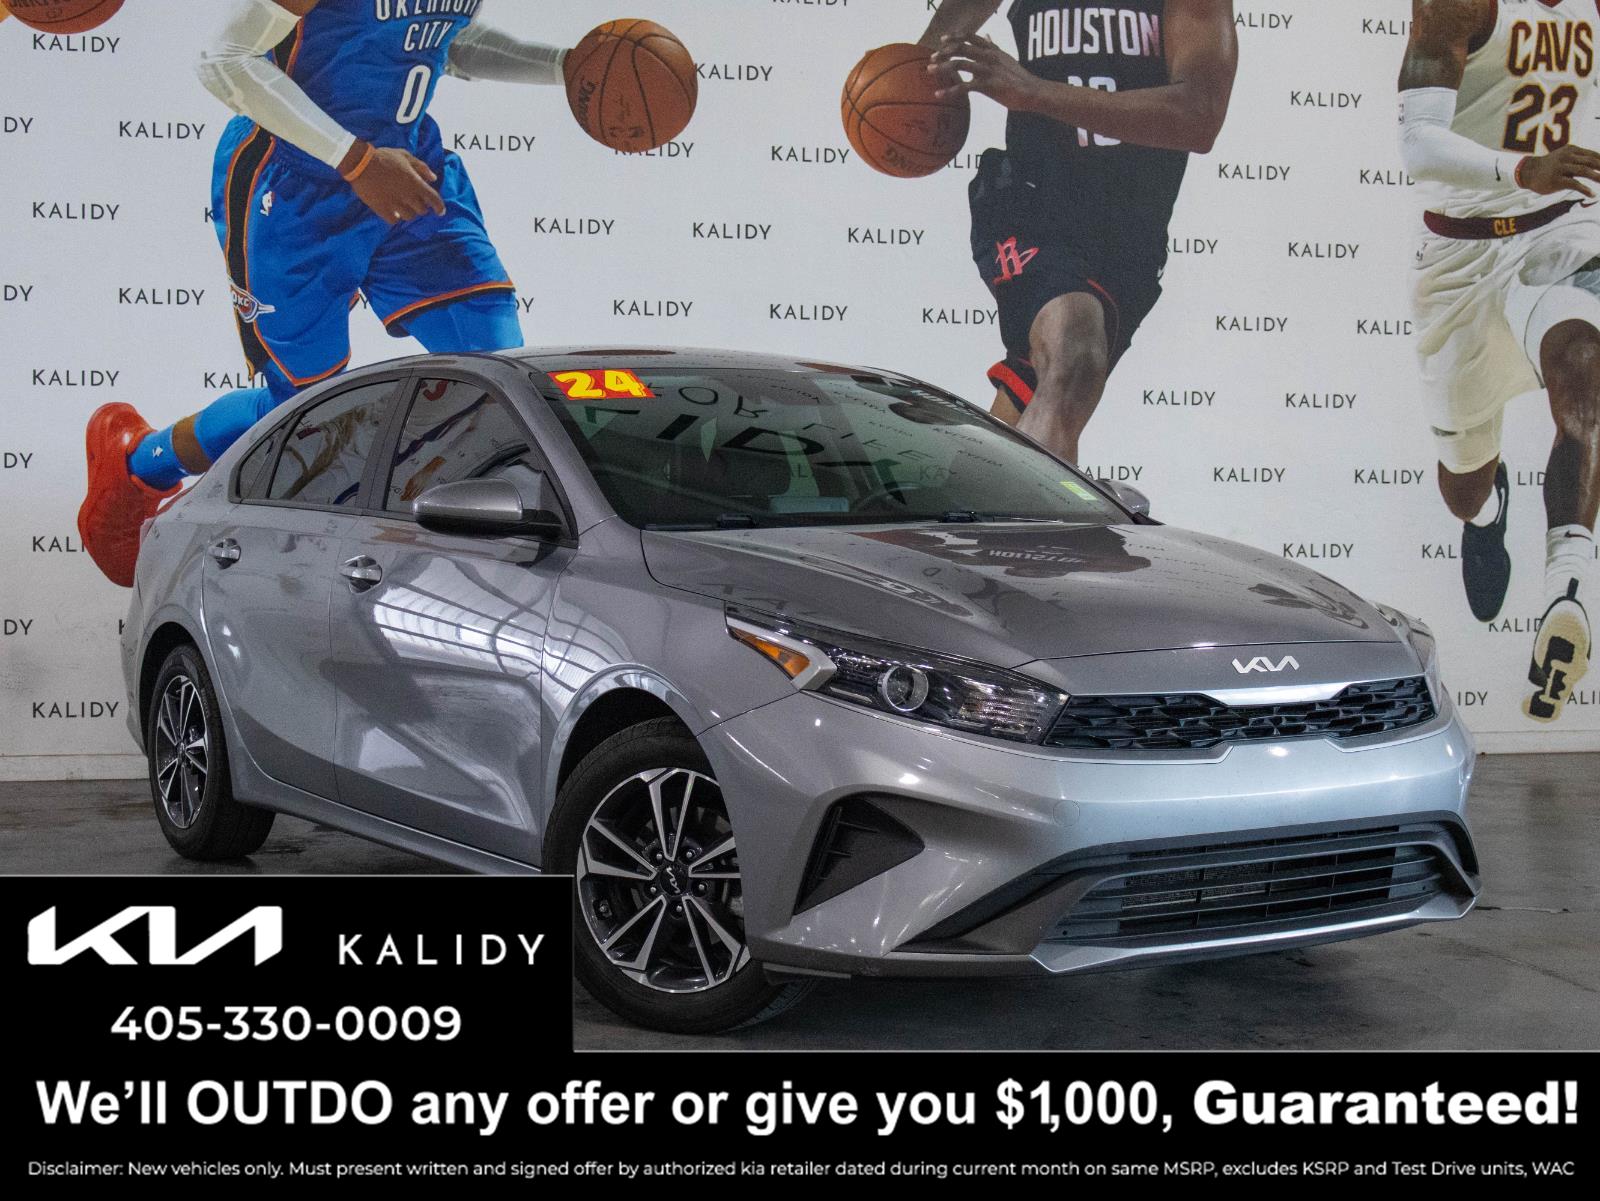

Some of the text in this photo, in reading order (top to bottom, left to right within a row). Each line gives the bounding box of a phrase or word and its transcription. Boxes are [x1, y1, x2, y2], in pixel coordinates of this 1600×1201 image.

[1235, 13, 1293, 29] ALIDY
[1363, 19, 1413, 36] KALI
[404, 21, 453, 52] CITY
[1027, 7, 1161, 61] HOUSTON
[33, 33, 120, 53] KALIDY
[1507, 19, 1593, 77] CAVS
[694, 63, 772, 82] KALIDY
[395, 64, 432, 125] 0
[1291, 91, 1361, 108] KALIDY
[1502, 83, 1578, 154] 23
[120, 121, 205, 139] KALIDY
[454, 134, 535, 152] KALIDY
[771, 146, 850, 163] KALIDY
[1219, 164, 1290, 181] KALIDY
[33, 202, 119, 221] KALIDY
[535, 218, 614, 235] KALIDY
[693, 223, 771, 240] KALIDY
[1493, 217, 1516, 236] CLE
[849, 228, 924, 245] KALIDY
[1168, 239, 1218, 254] LIDY
[1289, 243, 1359, 259] KALIDY
[120, 288, 204, 305] KALIDY
[614, 300, 692, 317] KALIDY
[770, 304, 847, 321] KALIDY
[923, 308, 998, 325] KALIDY
[1217, 316, 1287, 333] KALIDY
[33, 370, 119, 387] KALIDY
[554, 370, 646, 398] 24
[1144, 390, 1216, 406] KALIDY
[1286, 393, 1356, 409] KALIDY
[1086, 466, 1142, 481] ALIDY
[1214, 468, 1285, 483] KALIDY
[1355, 469, 1424, 485] KALIDY
[1283, 544, 1354, 559] KALIDY
[1422, 544, 1461, 559] KAL
[33, 702, 119, 719] KALIDY
